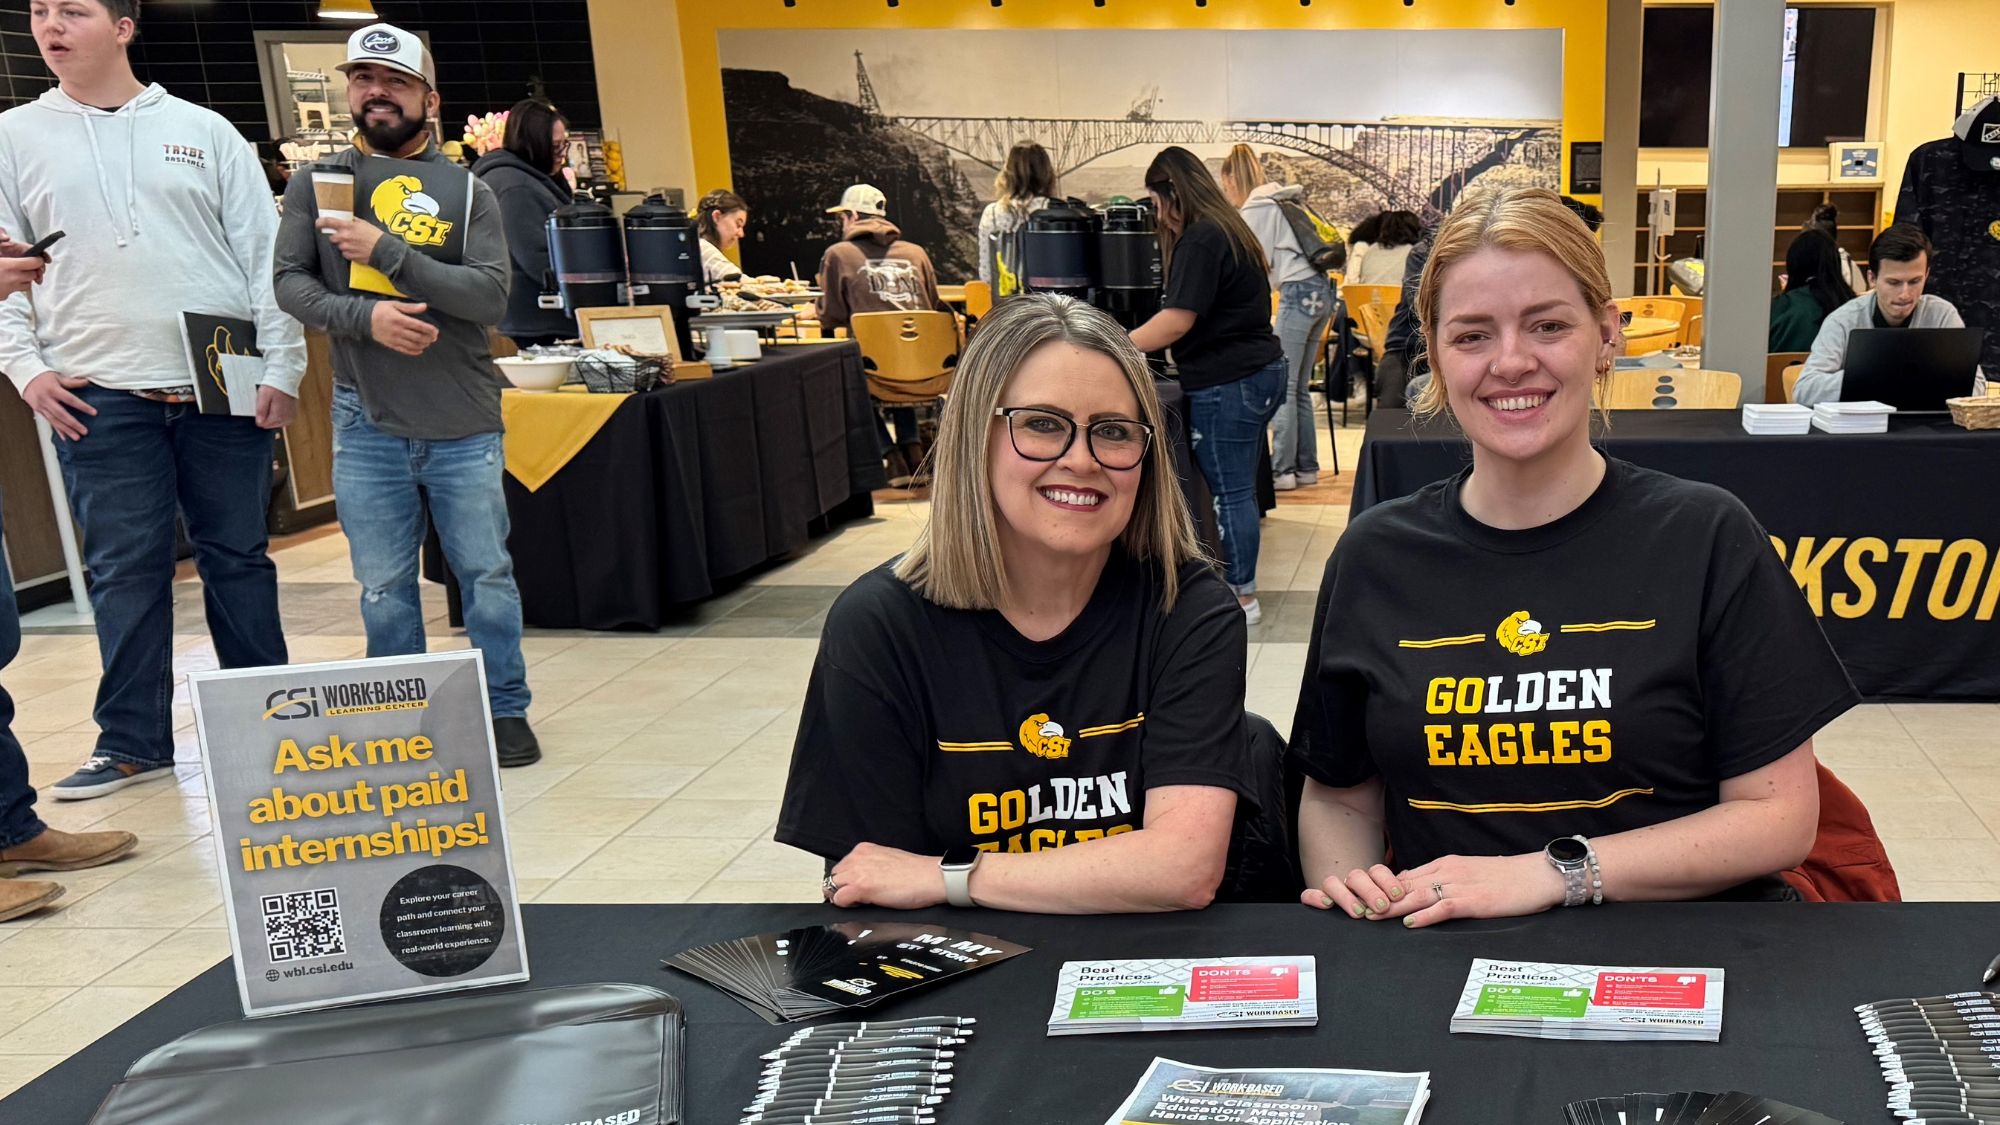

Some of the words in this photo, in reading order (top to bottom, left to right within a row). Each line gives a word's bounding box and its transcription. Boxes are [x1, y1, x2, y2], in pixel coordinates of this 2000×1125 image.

[163, 144, 205, 160] TRIBE
[390, 211, 453, 246] CSI
[1768, 535, 2000, 621] KSTO
[1510, 632, 1550, 656] CSI
[263, 687, 319, 720] CSI
[322, 677, 427, 708] WORK-BASED
[1426, 668, 1612, 714] GOLDEN
[329, 705, 382, 715] LEARNING
[385, 701, 424, 710] CENTER
[1036, 736, 1072, 759] CSI
[1424, 719, 1612, 766] EAGLES
[273, 735, 361, 775] Ask
[365, 735, 434, 765] me
[248, 780, 376, 824] about
[380, 768, 469, 817] paid
[968, 771, 1132, 835] GOLDEN
[239, 812, 490, 872] internships!
[400, 896, 432, 905] Explore
[432, 893, 450, 901] your
[452, 890, 478, 898] career
[396, 912, 416, 923] path
[417, 911, 433, 919] and
[434, 907, 466, 917] connect
[467, 905, 486, 913] your
[396, 927, 439, 938] classroom
[439, 923, 473, 933] learning
[473, 919, 492, 928] with
[401, 942, 443, 954] real-world
[444, 937, 492, 949] experience.
[949, 940, 1004, 957] MY
[929, 948, 979, 963] STORY
[1199, 969, 1251, 977] DON'TS
[1488, 964, 1523, 972] Best
[1486, 973, 1558, 981] Practices
[1604, 975, 1658, 983] DON'TS
[1167, 1079, 1209, 1093] CSI
[1154, 1102, 1246, 1115] Education
[1249, 1108, 1305, 1119] Meets
[1161, 1094, 1218, 1106] Where
[1223, 1099, 1319, 1111] Classroom
[1149, 1110, 1241, 1123] Hands-On
